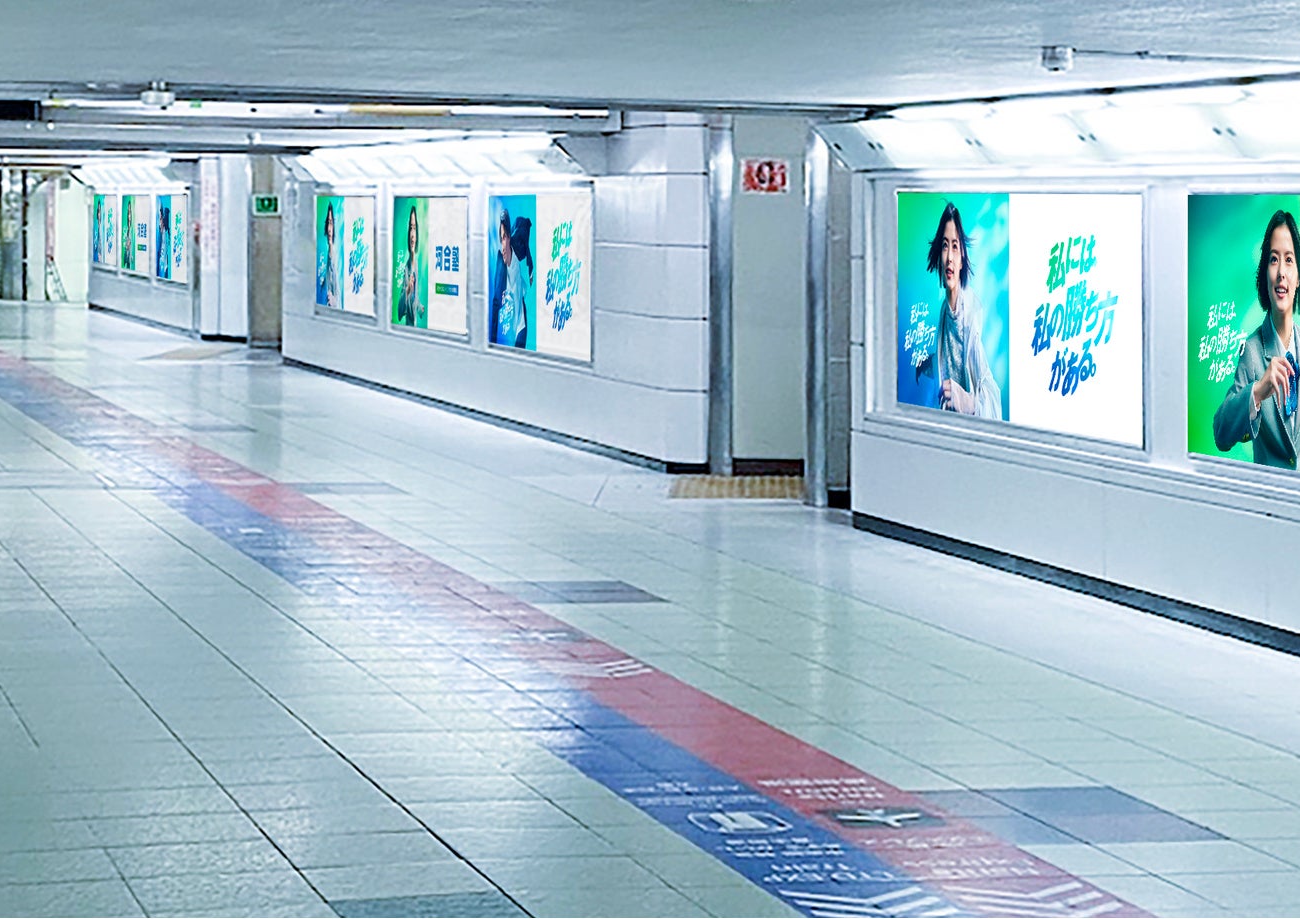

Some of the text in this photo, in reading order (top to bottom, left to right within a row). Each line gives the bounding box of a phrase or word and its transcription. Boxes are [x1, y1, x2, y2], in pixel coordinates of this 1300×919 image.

[1031, 279, 1119, 357] 私の勝ち方
[1048, 337, 1097, 397] がある。
